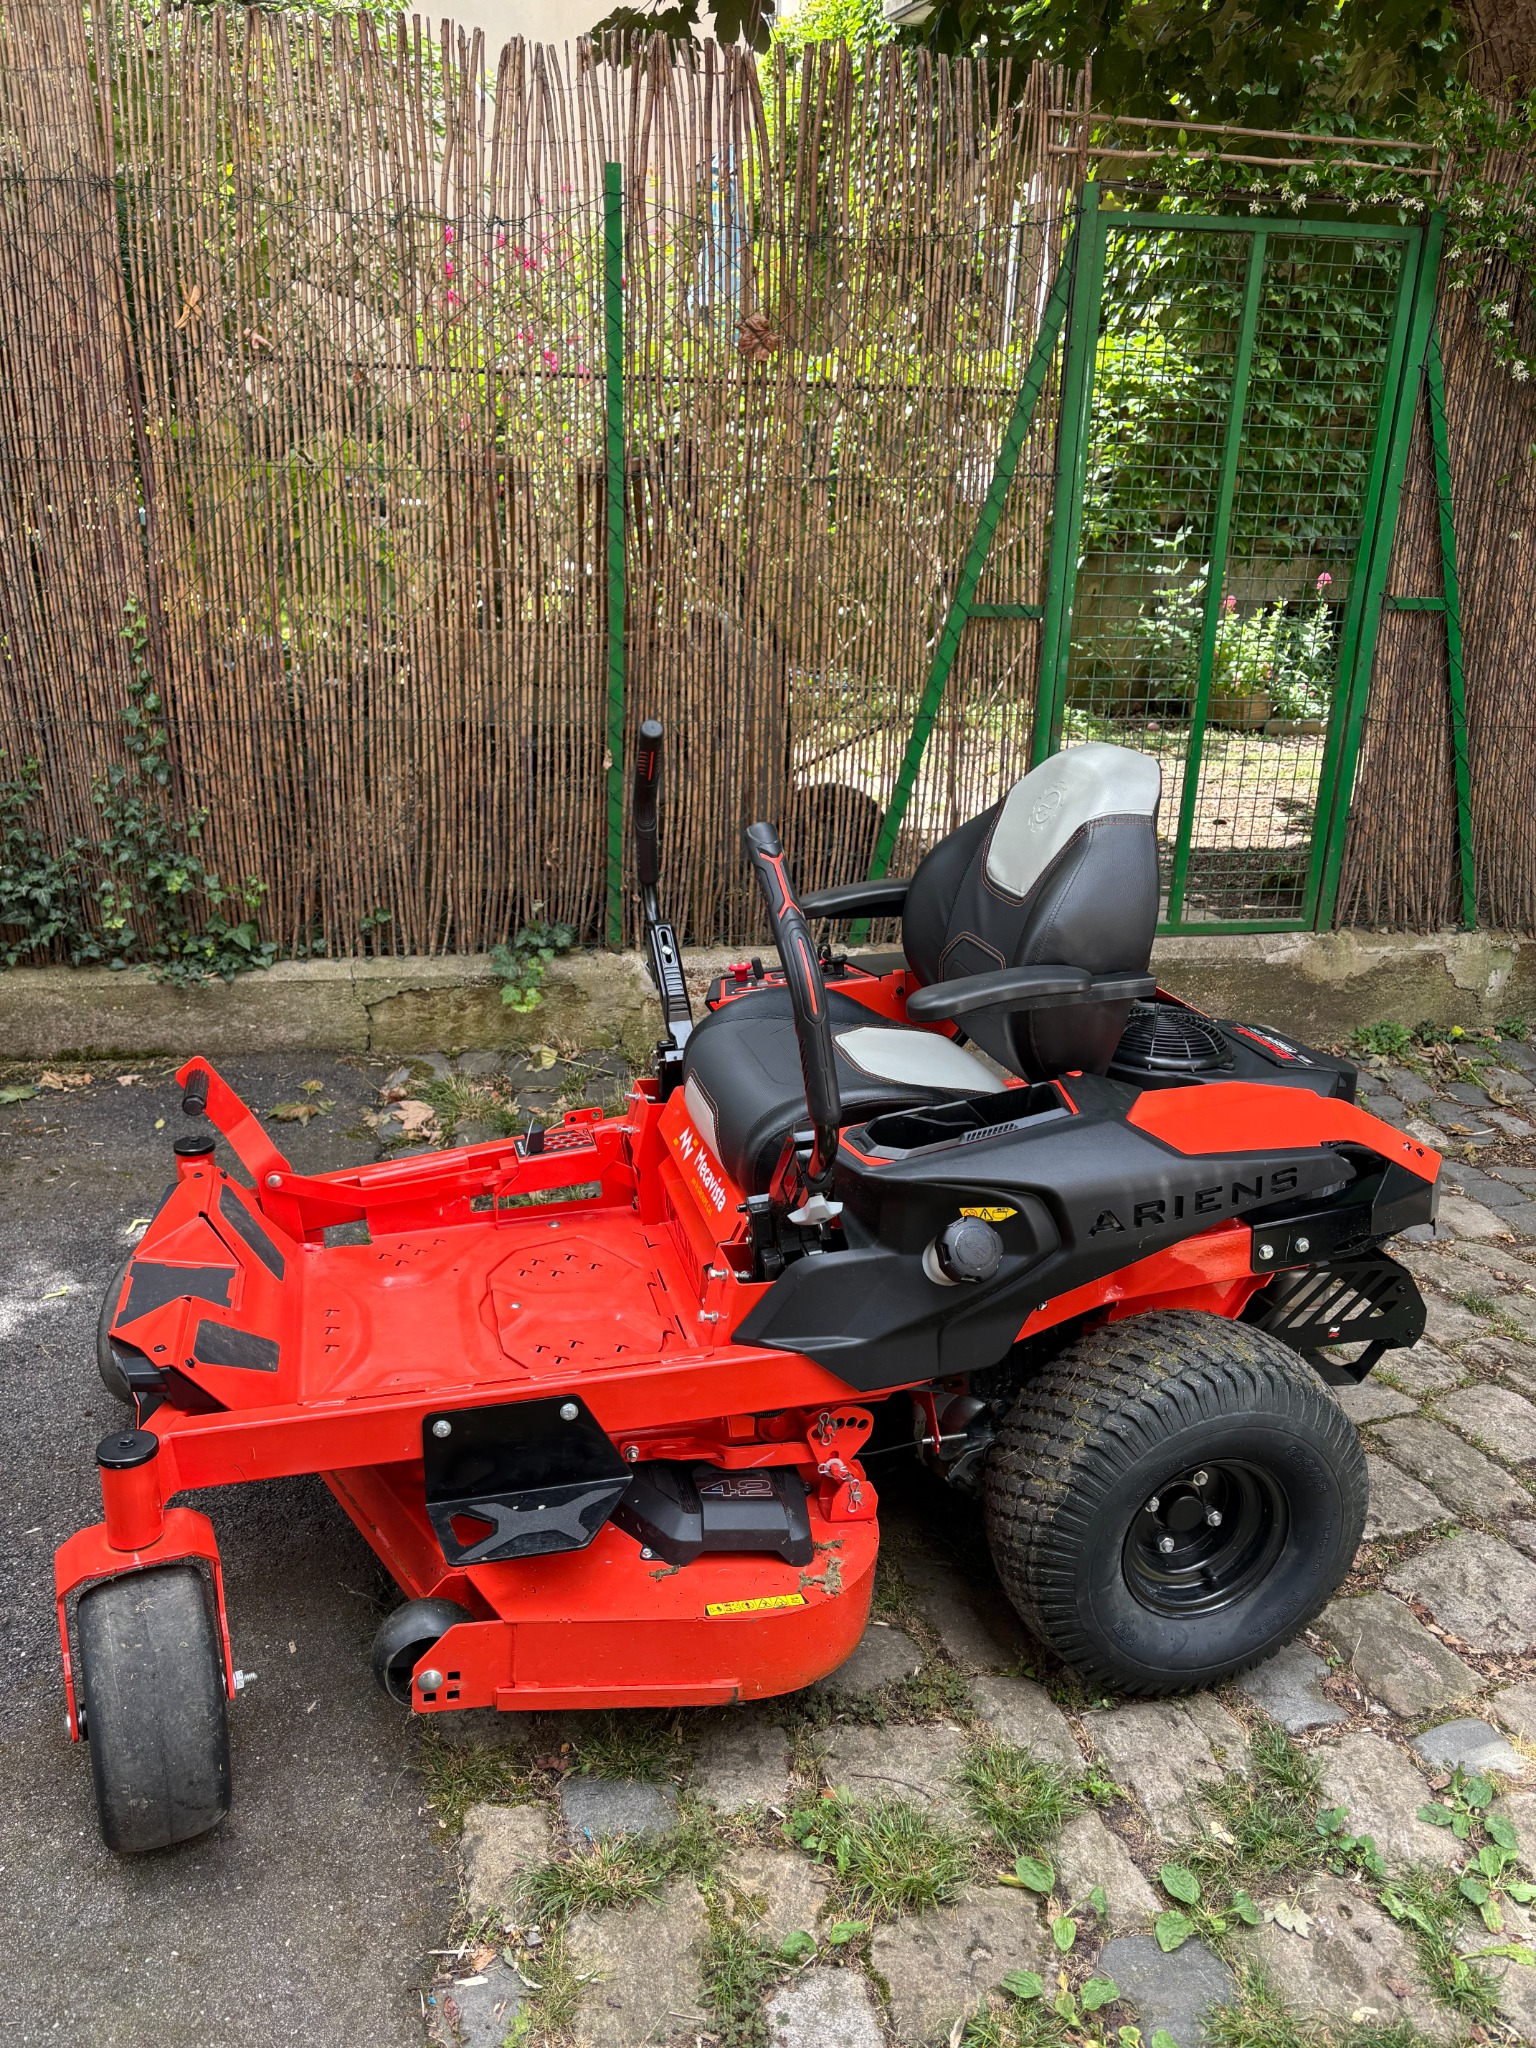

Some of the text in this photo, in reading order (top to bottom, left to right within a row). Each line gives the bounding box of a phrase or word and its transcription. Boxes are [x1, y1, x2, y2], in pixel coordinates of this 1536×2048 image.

[693, 1146, 727, 1213] Mecavista
[1085, 1166, 1298, 1240] ARIENS
[700, 1479, 774, 1497] 42
